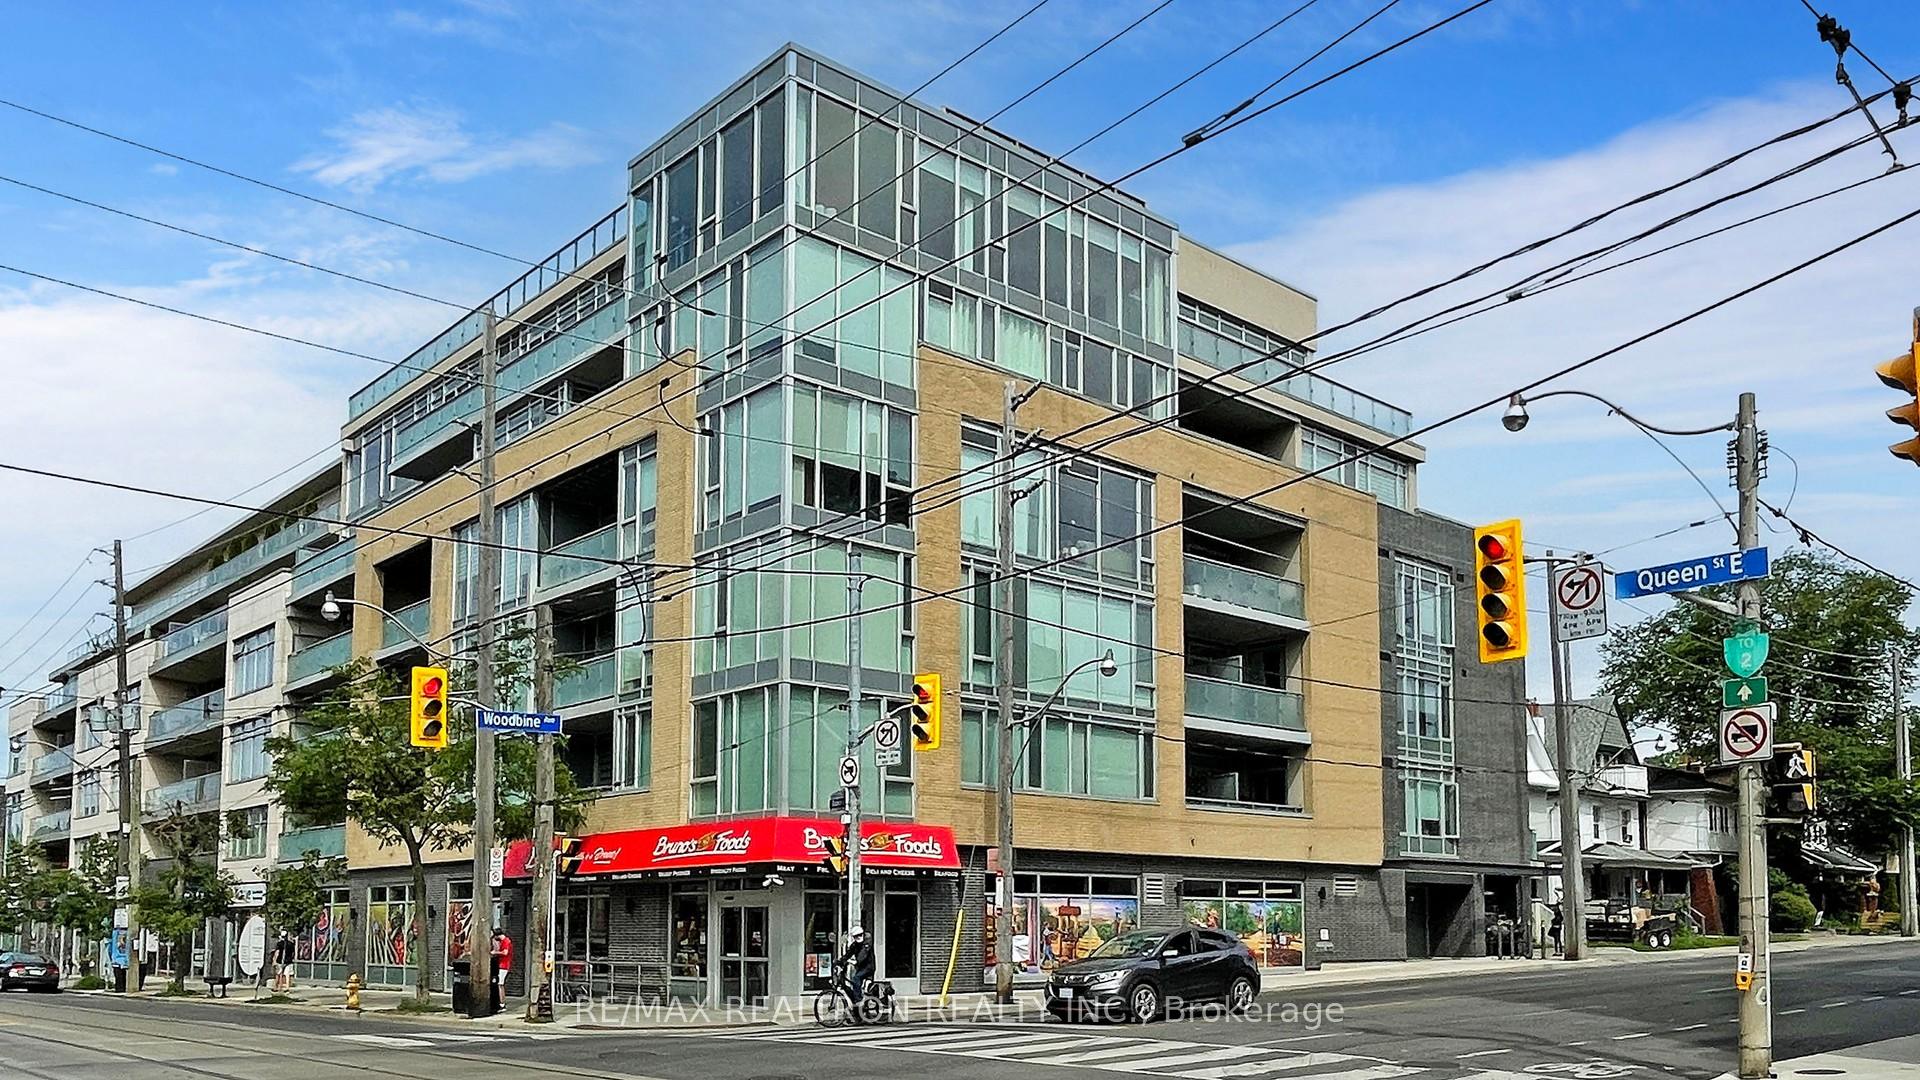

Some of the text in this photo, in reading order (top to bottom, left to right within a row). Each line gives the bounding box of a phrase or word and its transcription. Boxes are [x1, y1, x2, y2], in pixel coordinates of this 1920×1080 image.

[1637, 552, 1744, 591] Queen St E
[1741, 652, 1752, 669] 2
[483, 711, 541, 728] Woodbine
[652, 829, 752, 857] Bruno's Foods
[895, 832, 942, 855] Foods
